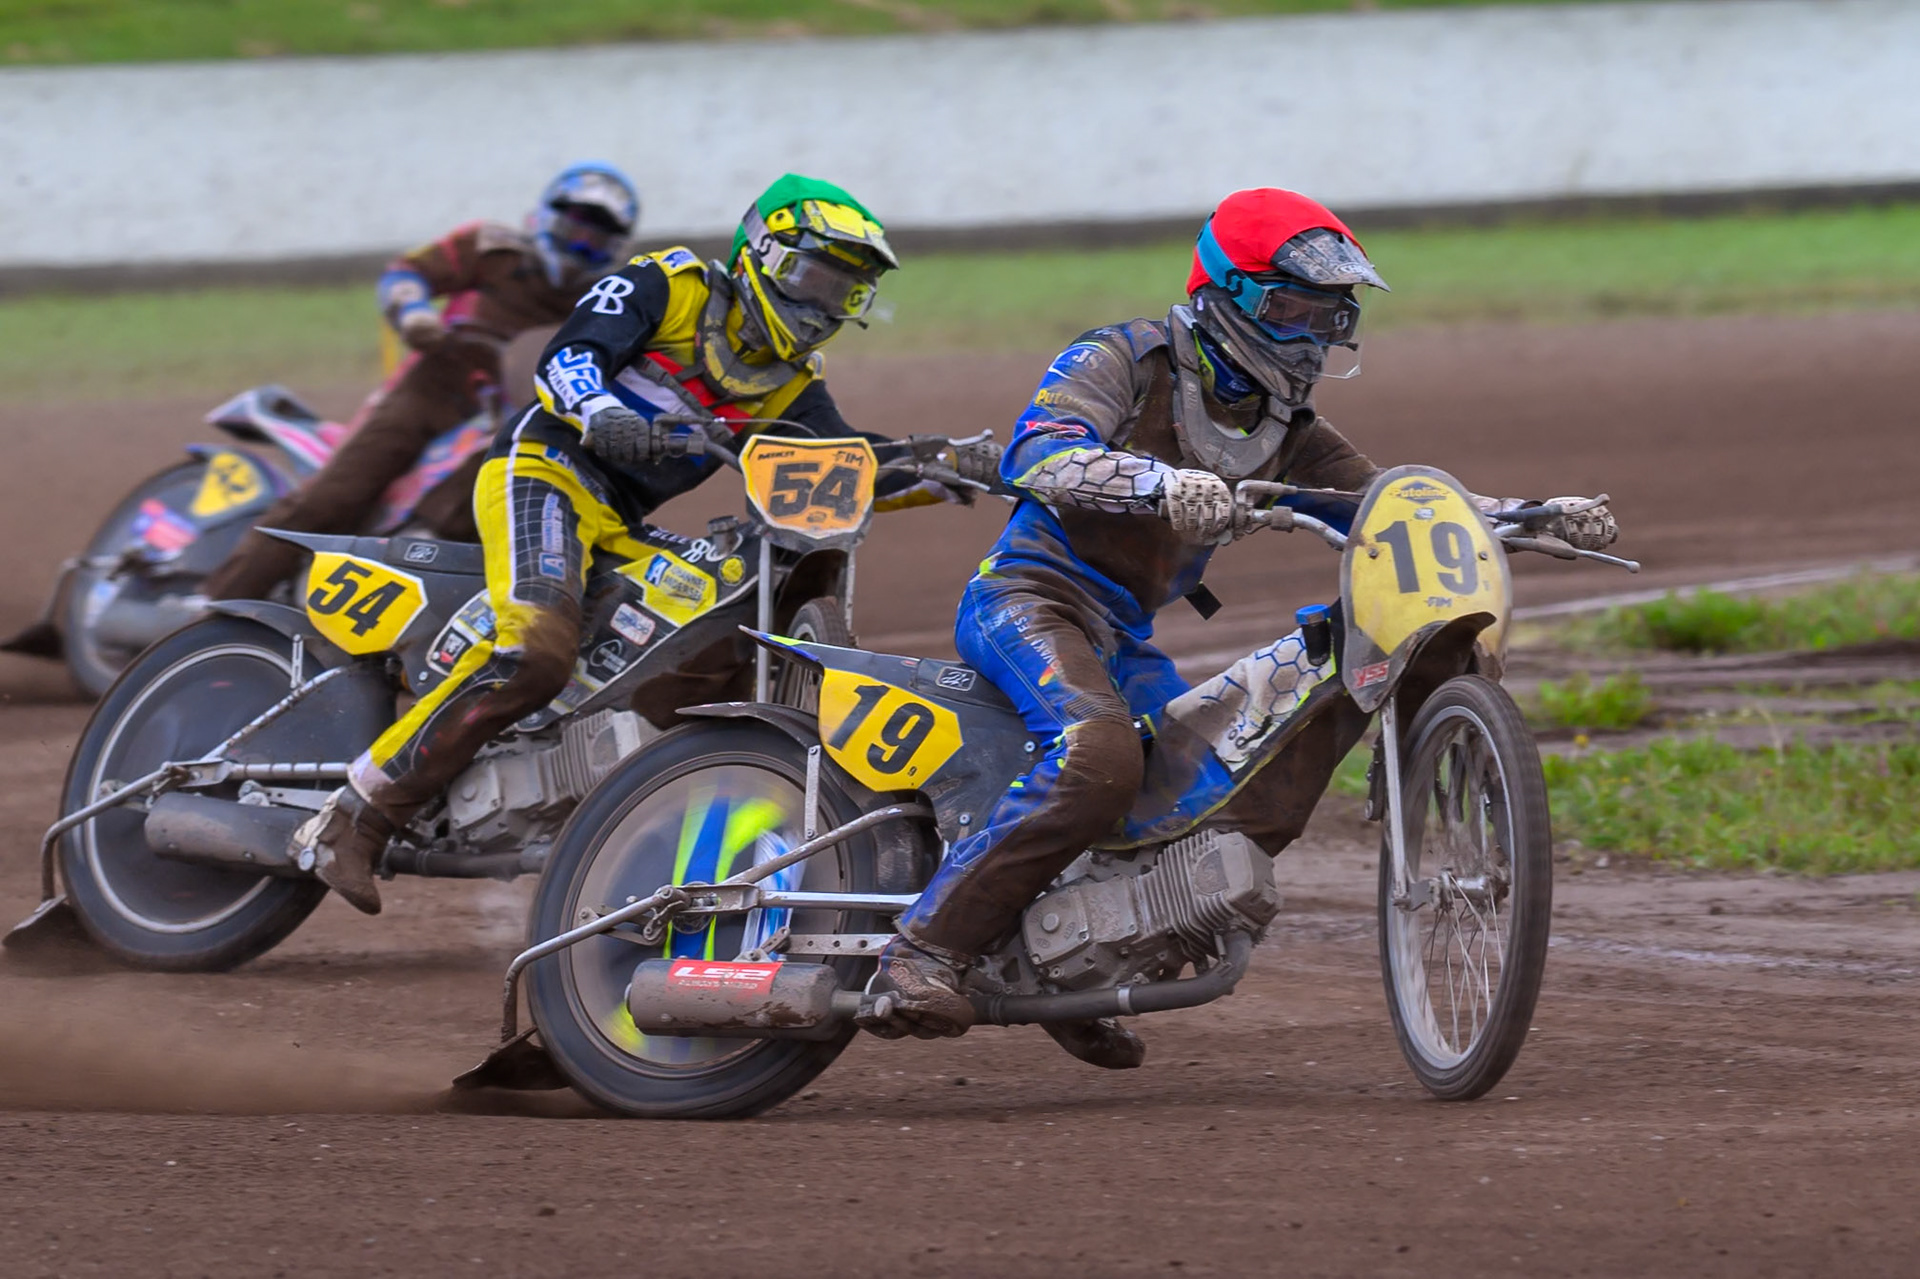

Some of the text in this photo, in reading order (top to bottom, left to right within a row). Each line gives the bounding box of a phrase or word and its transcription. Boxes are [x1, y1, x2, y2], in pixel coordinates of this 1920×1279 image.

[769, 462, 859, 521] 54
[1375, 520, 1478, 596] 19
[307, 560, 407, 637] 54
[828, 684, 935, 775] 19
[674, 966, 772, 981] LS2
